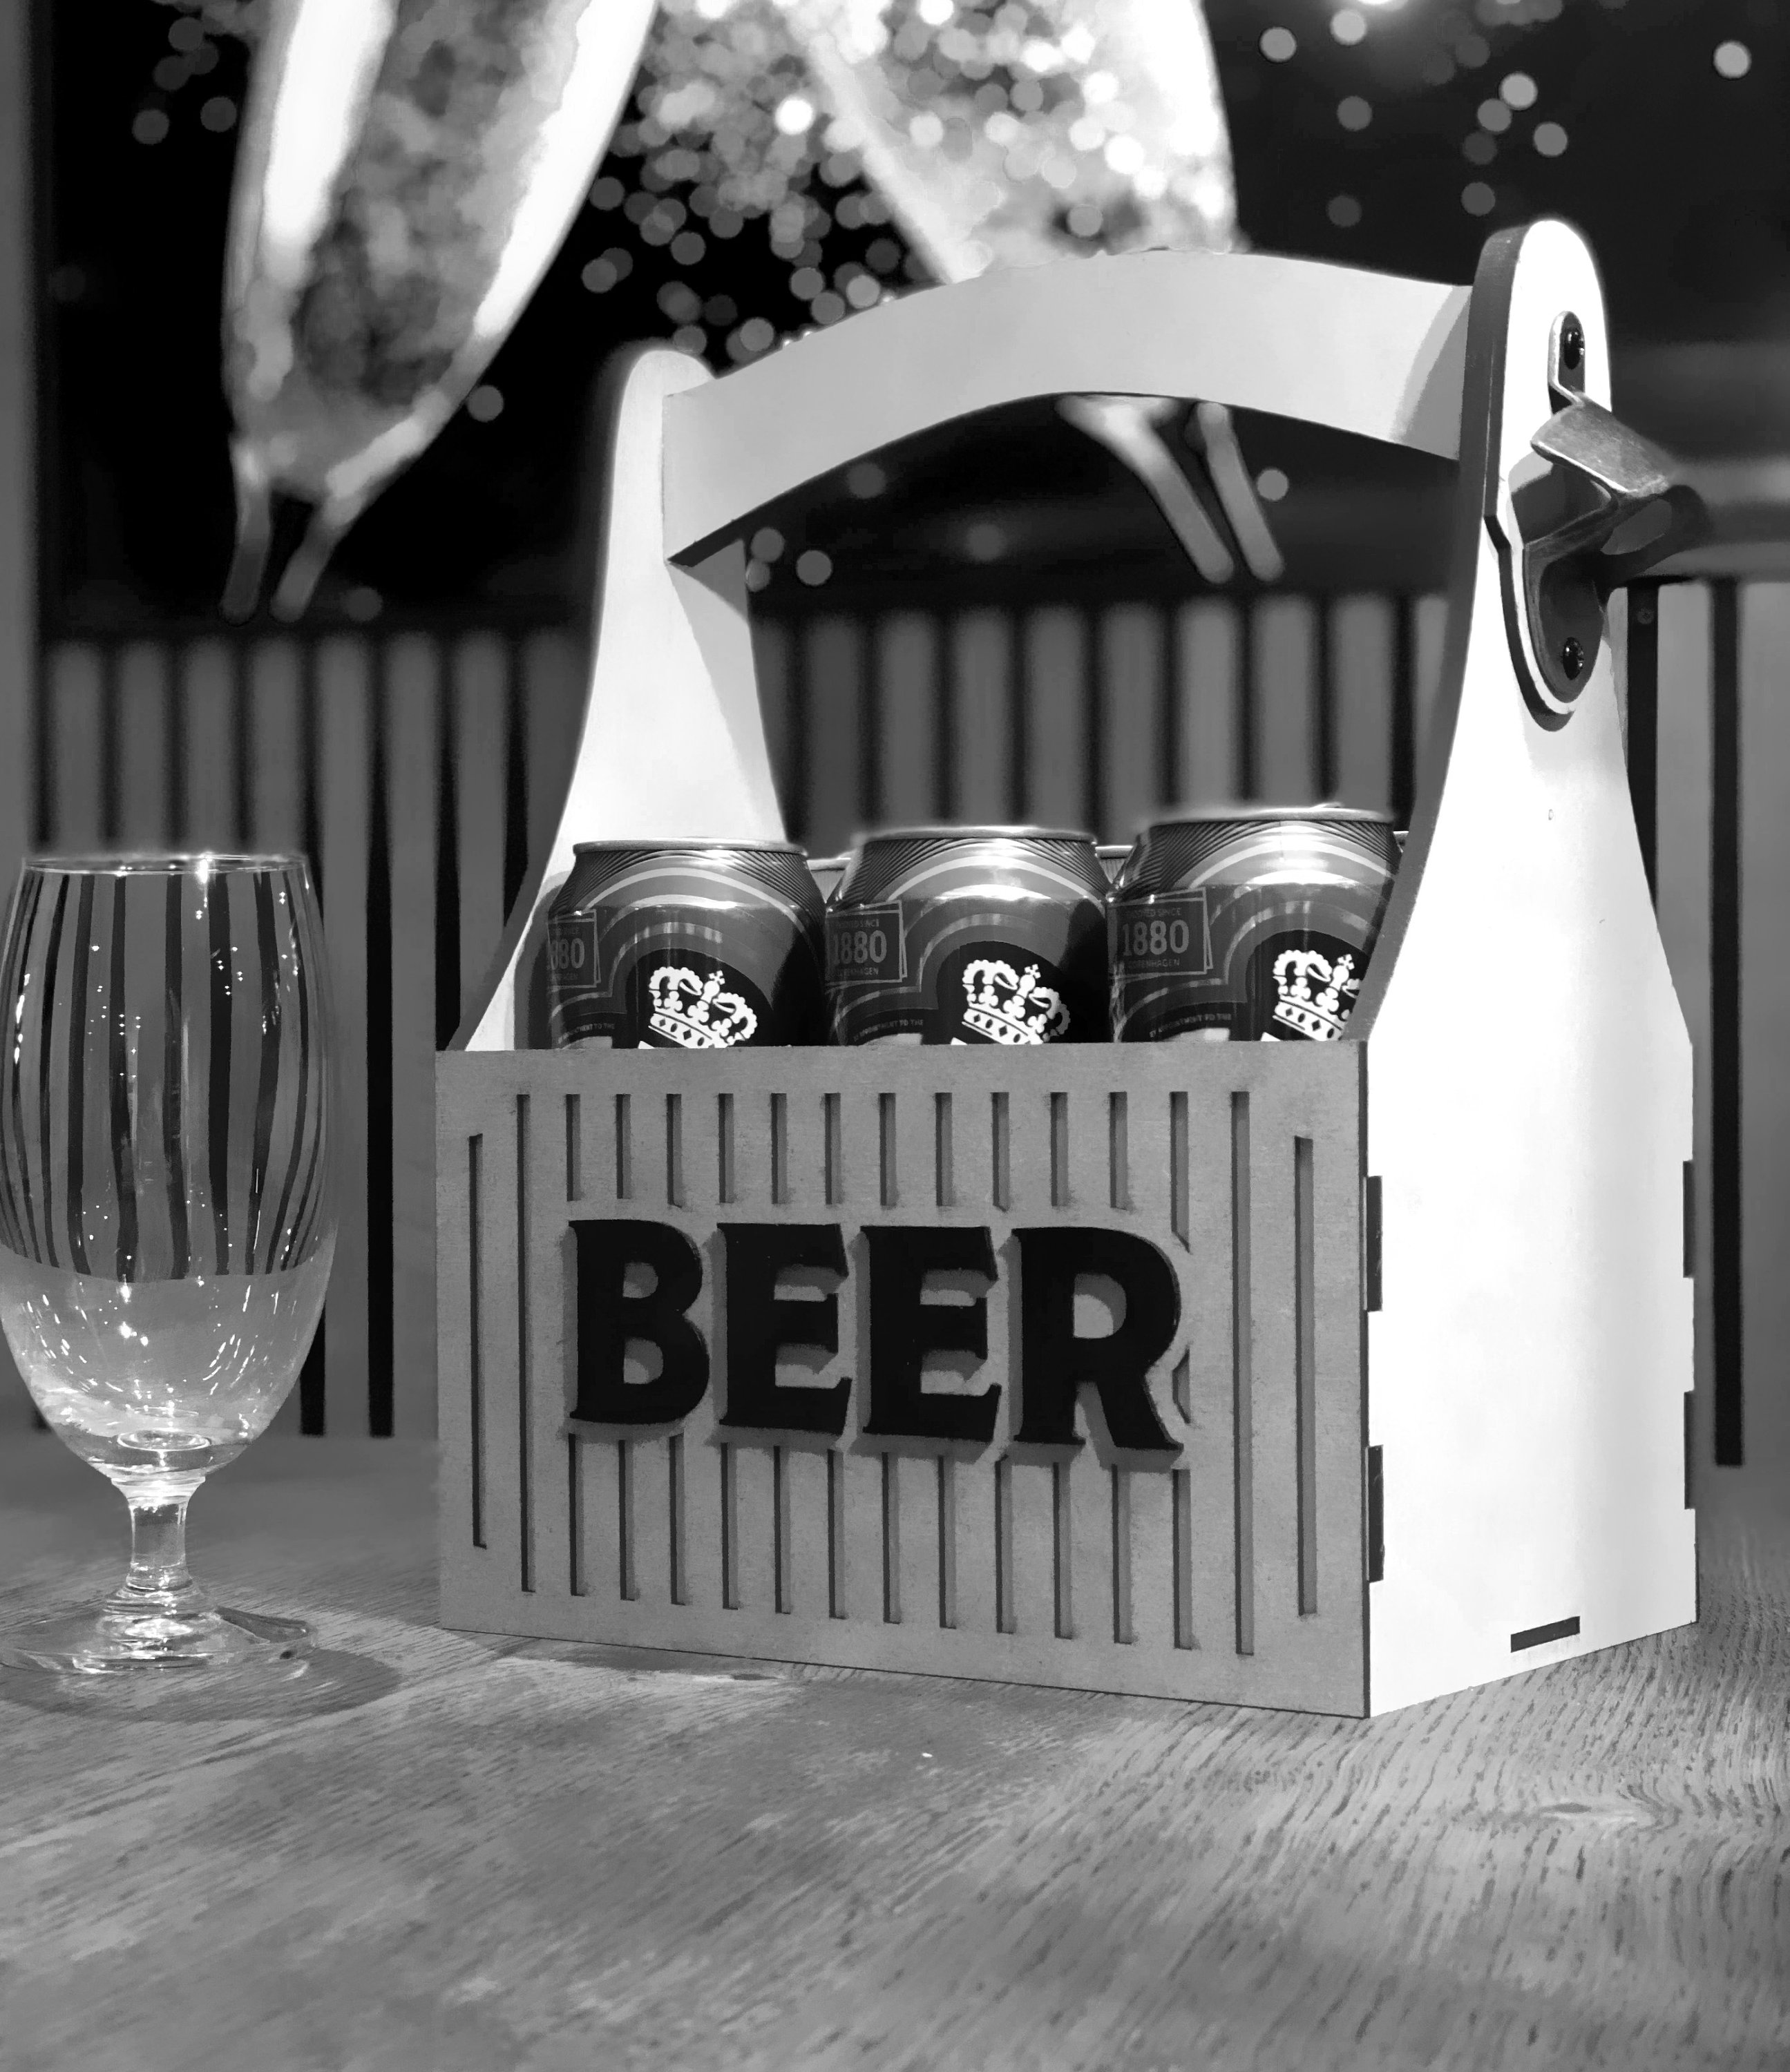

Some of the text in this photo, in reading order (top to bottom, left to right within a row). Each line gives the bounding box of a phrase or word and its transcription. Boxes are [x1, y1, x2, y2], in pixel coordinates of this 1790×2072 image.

[832, 930, 887, 965] 1880
[1123, 919, 1190, 957] 1880
[568, 1219, 1183, 1452] BEER
